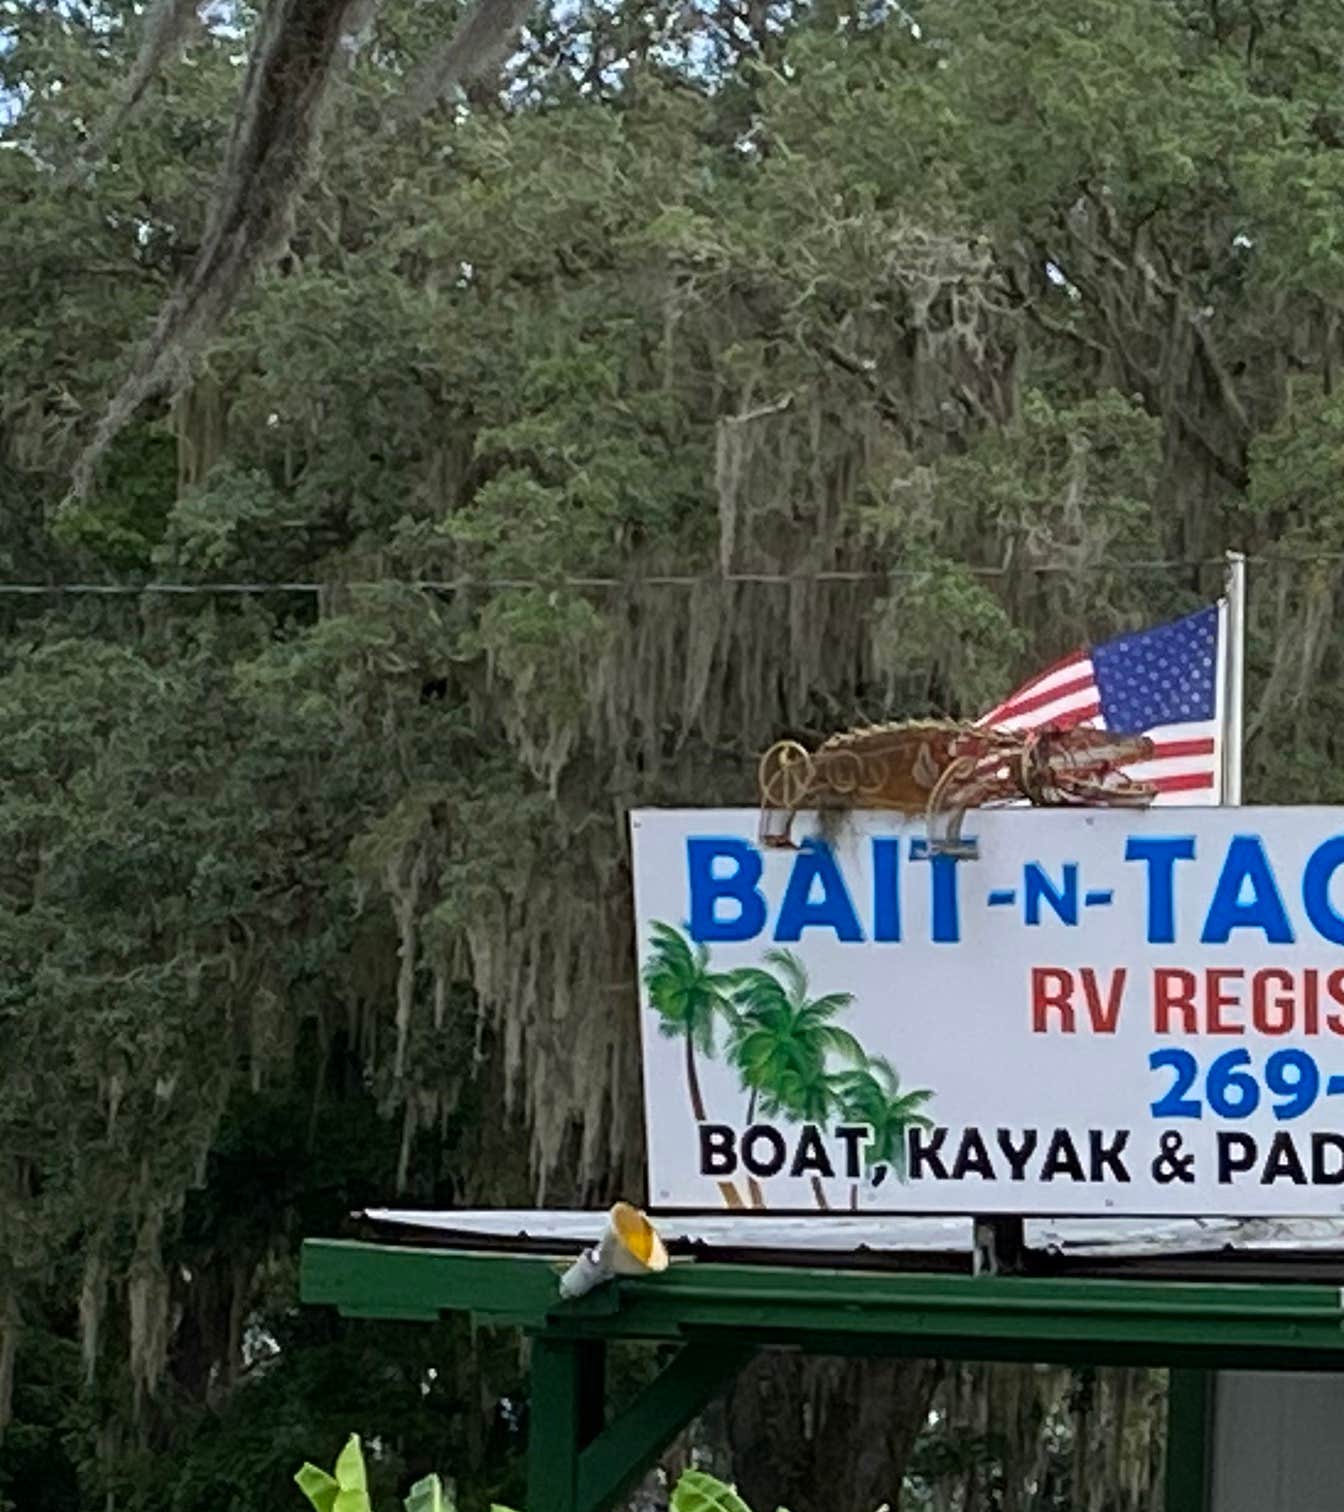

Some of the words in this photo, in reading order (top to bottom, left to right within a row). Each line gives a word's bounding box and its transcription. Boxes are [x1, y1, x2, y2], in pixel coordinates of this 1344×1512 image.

[1031, 967, 1124, 1032] RV
[699, 1124, 888, 1188] BOAT,
[908, 1126, 1131, 1183] KAYAK
[1152, 1130, 1196, 1184] &
